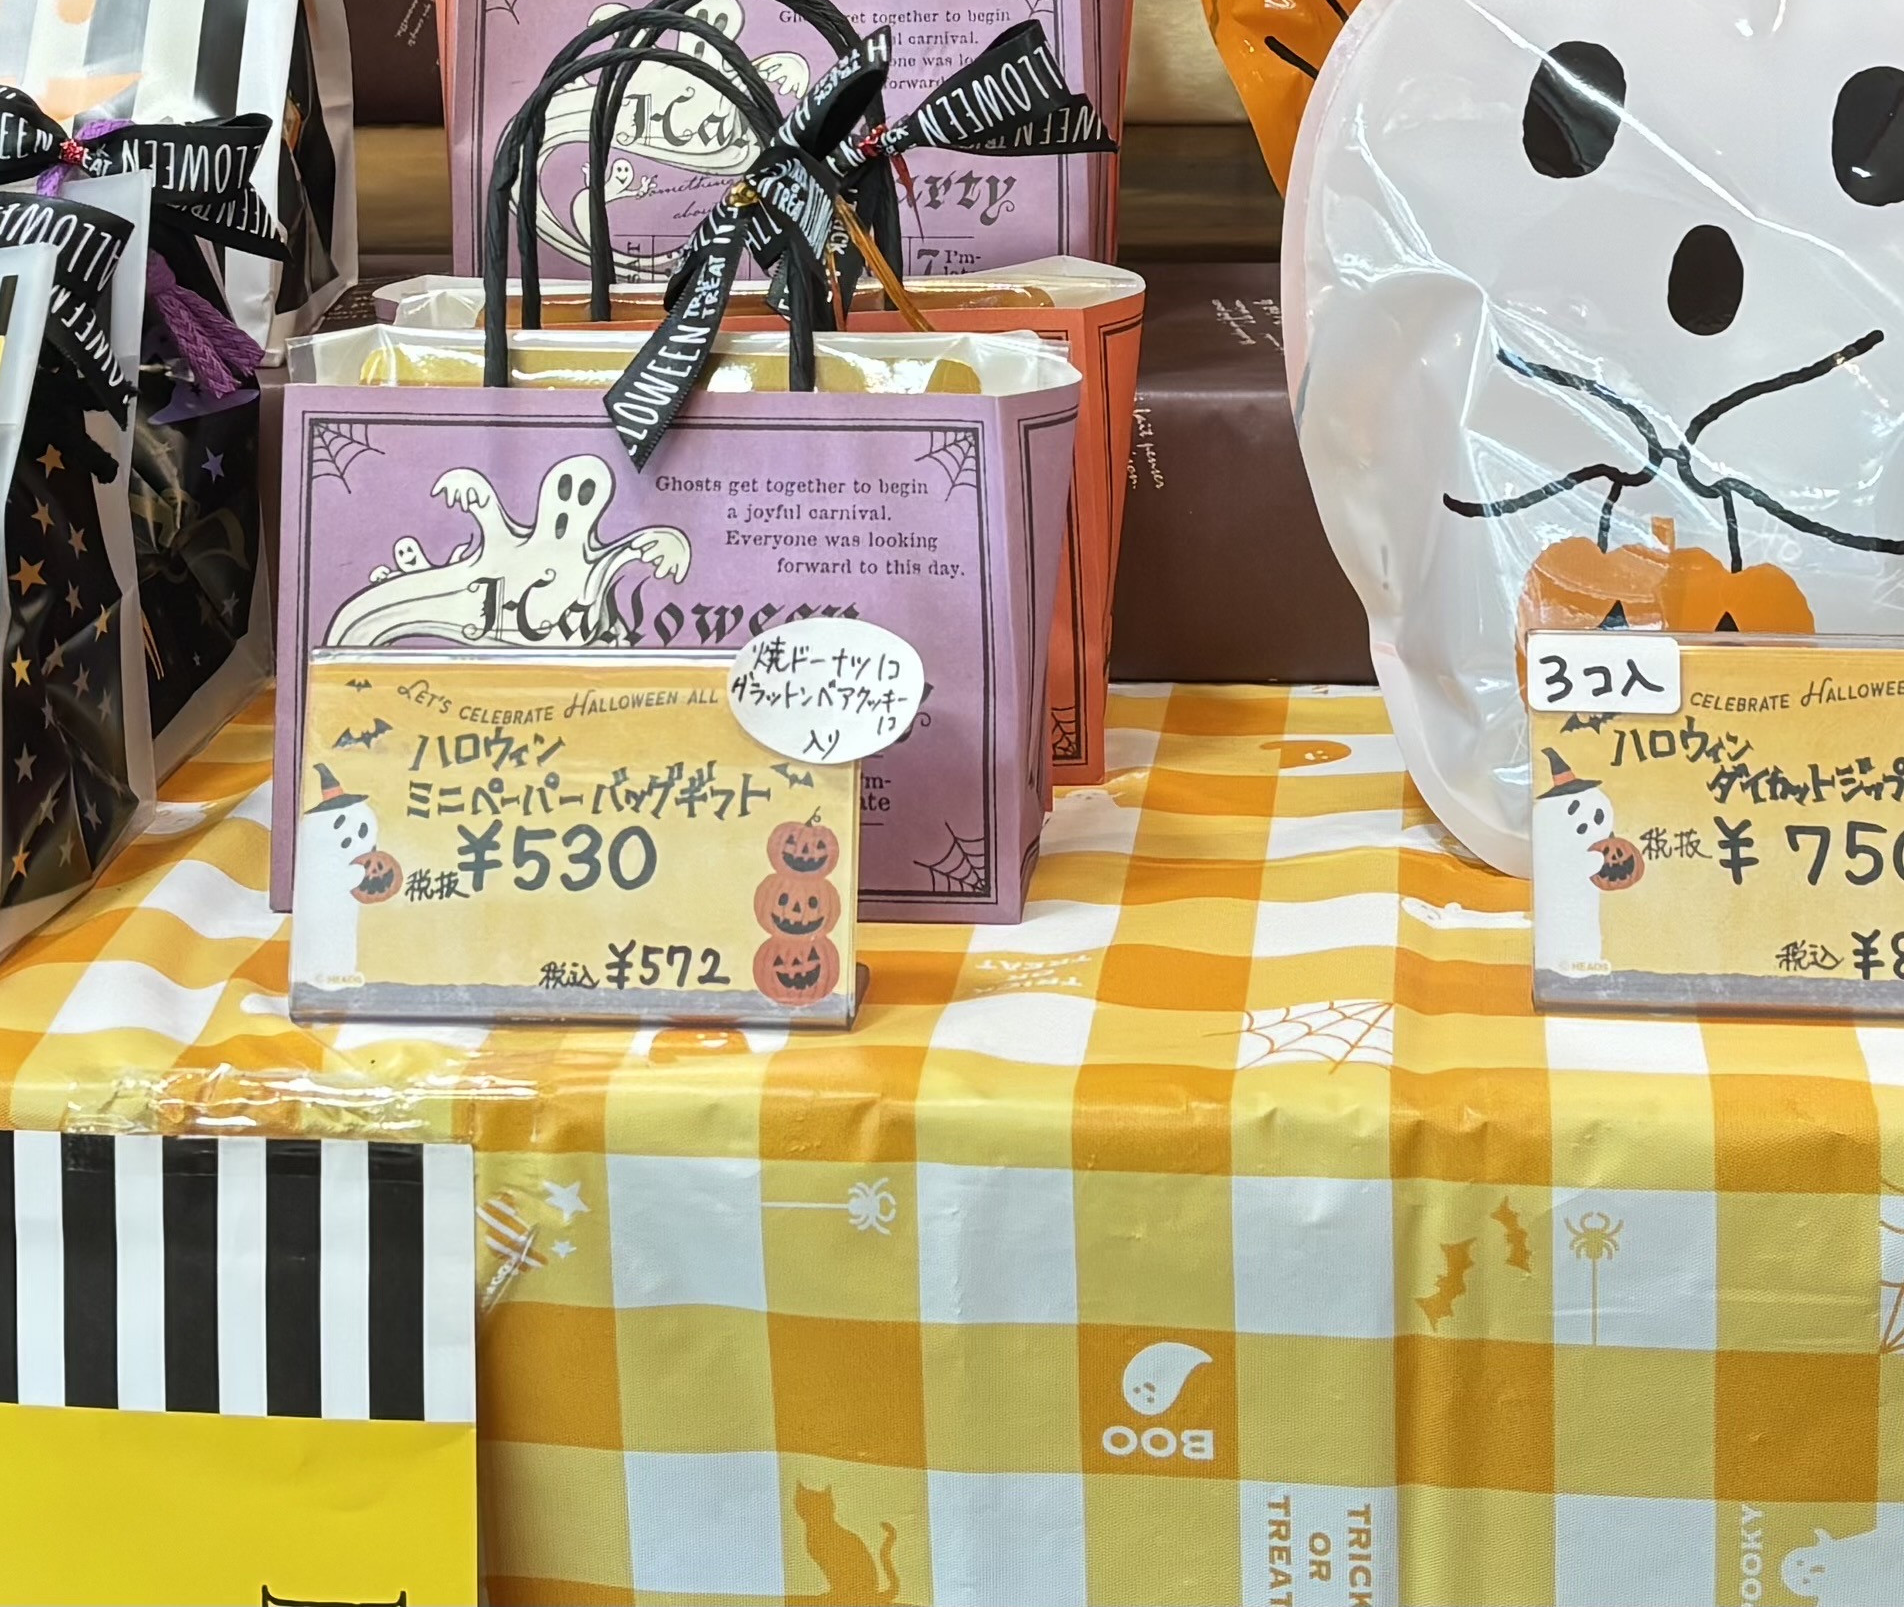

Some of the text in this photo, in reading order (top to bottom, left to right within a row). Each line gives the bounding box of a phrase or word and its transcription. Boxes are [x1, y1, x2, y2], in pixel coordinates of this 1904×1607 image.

[872, 9, 1010, 25] together to begin
[908, 32, 979, 44] carnival.
[655, 475, 929, 497] Ghosts get together to begin
[726, 504, 892, 523] a joyful carnival.
[725, 530, 938, 551] Everyone was looking
[777, 558, 965, 578] forward to this day.
[1537, 654, 1665, 703] 3コ入
[397, 679, 719, 726] LET'S CELEBRATE HALLOWEEN ALL
[1689, 691, 1790, 712] CELEBRATE
[406, 732, 568, 771] ハロウィン
[1610, 717, 1755, 768] ハロウィン
[406, 759, 773, 823] ミニペーパーバッグギフト
[455, 821, 659, 894] ¥530
[604, 938, 732, 990] ¥572
[1100, 1425, 1215, 1462] BOO
[1306, 1529, 1333, 1585] OR
